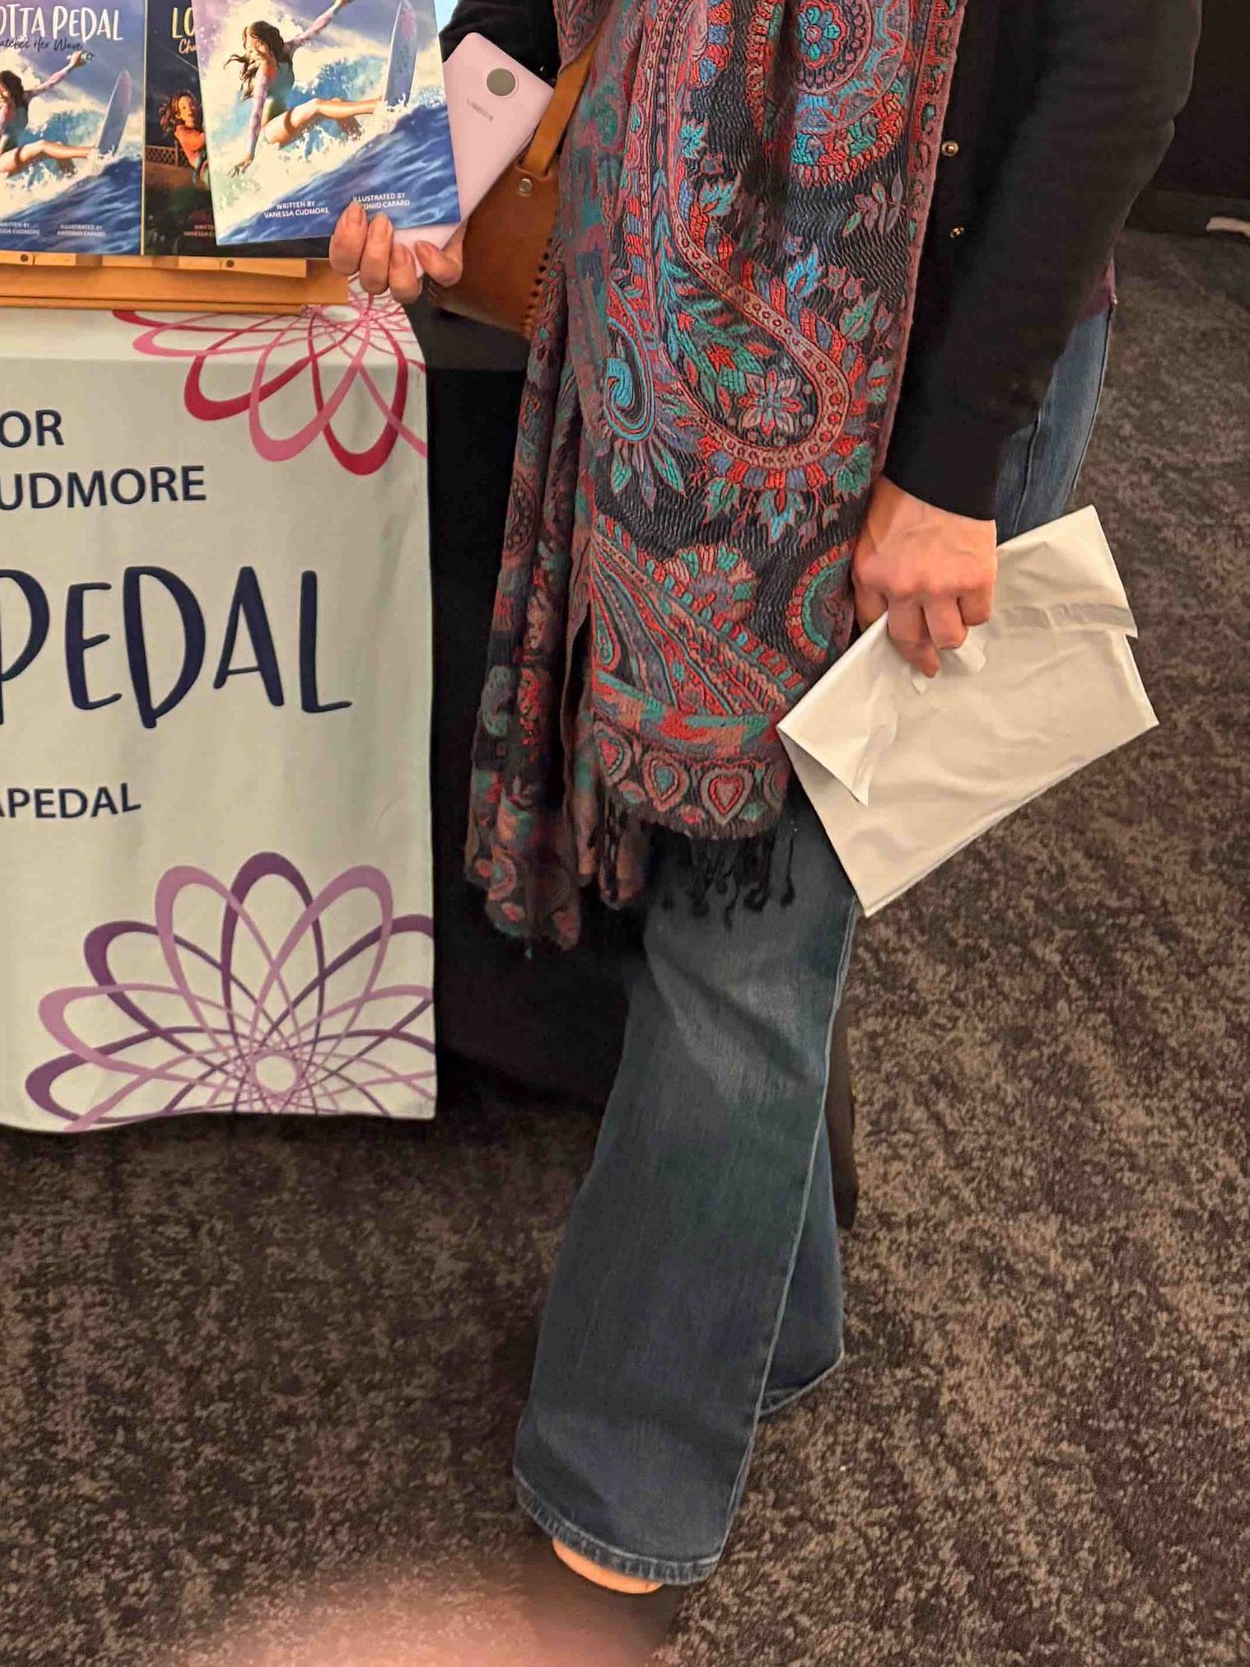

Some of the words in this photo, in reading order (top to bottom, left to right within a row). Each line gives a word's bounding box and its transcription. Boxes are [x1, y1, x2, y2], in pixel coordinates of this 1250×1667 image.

[52, 5, 124, 42] PEDAL
[33, 37, 49, 52] Her
[53, 37, 84, 51] Wave
[276, 201, 306, 210] WRITTEN
[306, 200, 316, 208] BY
[264, 209, 295, 219] VANESSA
[295, 207, 329, 216] CUDMORE
